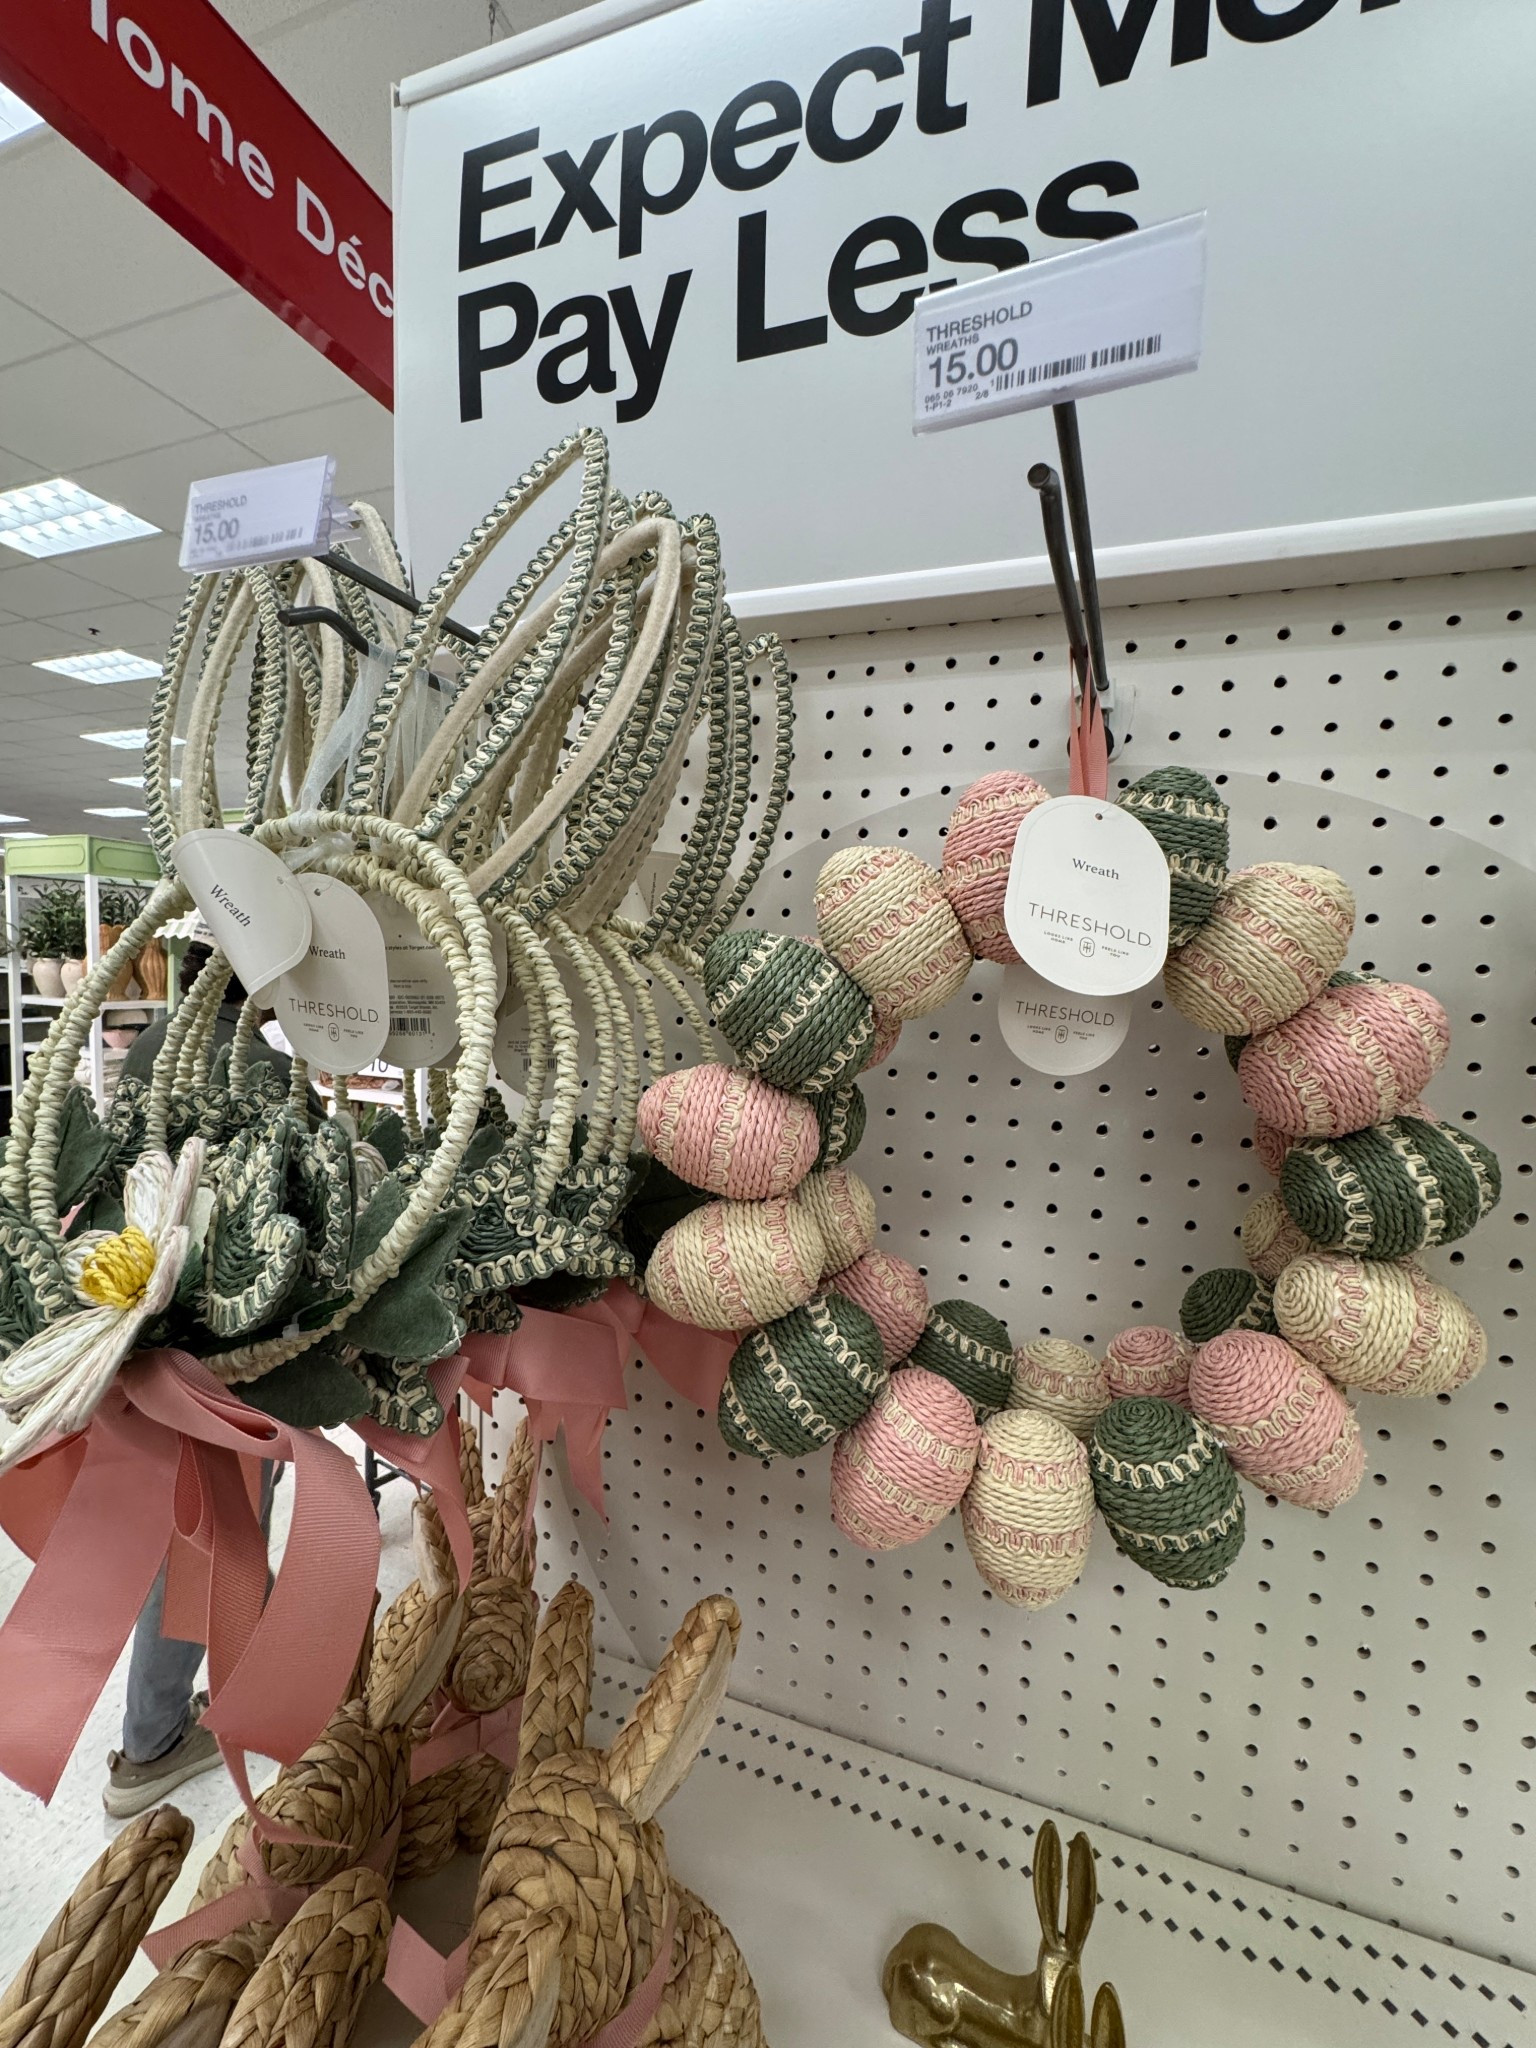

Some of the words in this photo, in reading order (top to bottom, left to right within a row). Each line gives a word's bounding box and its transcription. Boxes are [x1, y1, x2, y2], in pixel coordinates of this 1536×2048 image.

[459, 0, 973, 272] Expect
[459, 269, 693, 423] Pay
[737, 160, 1140, 362] Less
[926, 301, 1033, 343] THRESHOLD
[926, 334, 980, 356] WREATHS
[928, 337, 1019, 389] 15.00
[194, 494, 247, 513] THRESHOLD
[194, 517, 240, 546] 15.00
[1072, 858, 1120, 880] Wreath
[209, 884, 251, 928] Wreath
[1029, 902, 1152, 947] THRESHOLD
[309, 945, 346, 960] Wreath
[288, 997, 379, 1023] THRESHOLD
[1016, 1000, 1115, 1026] THRESHOLD
